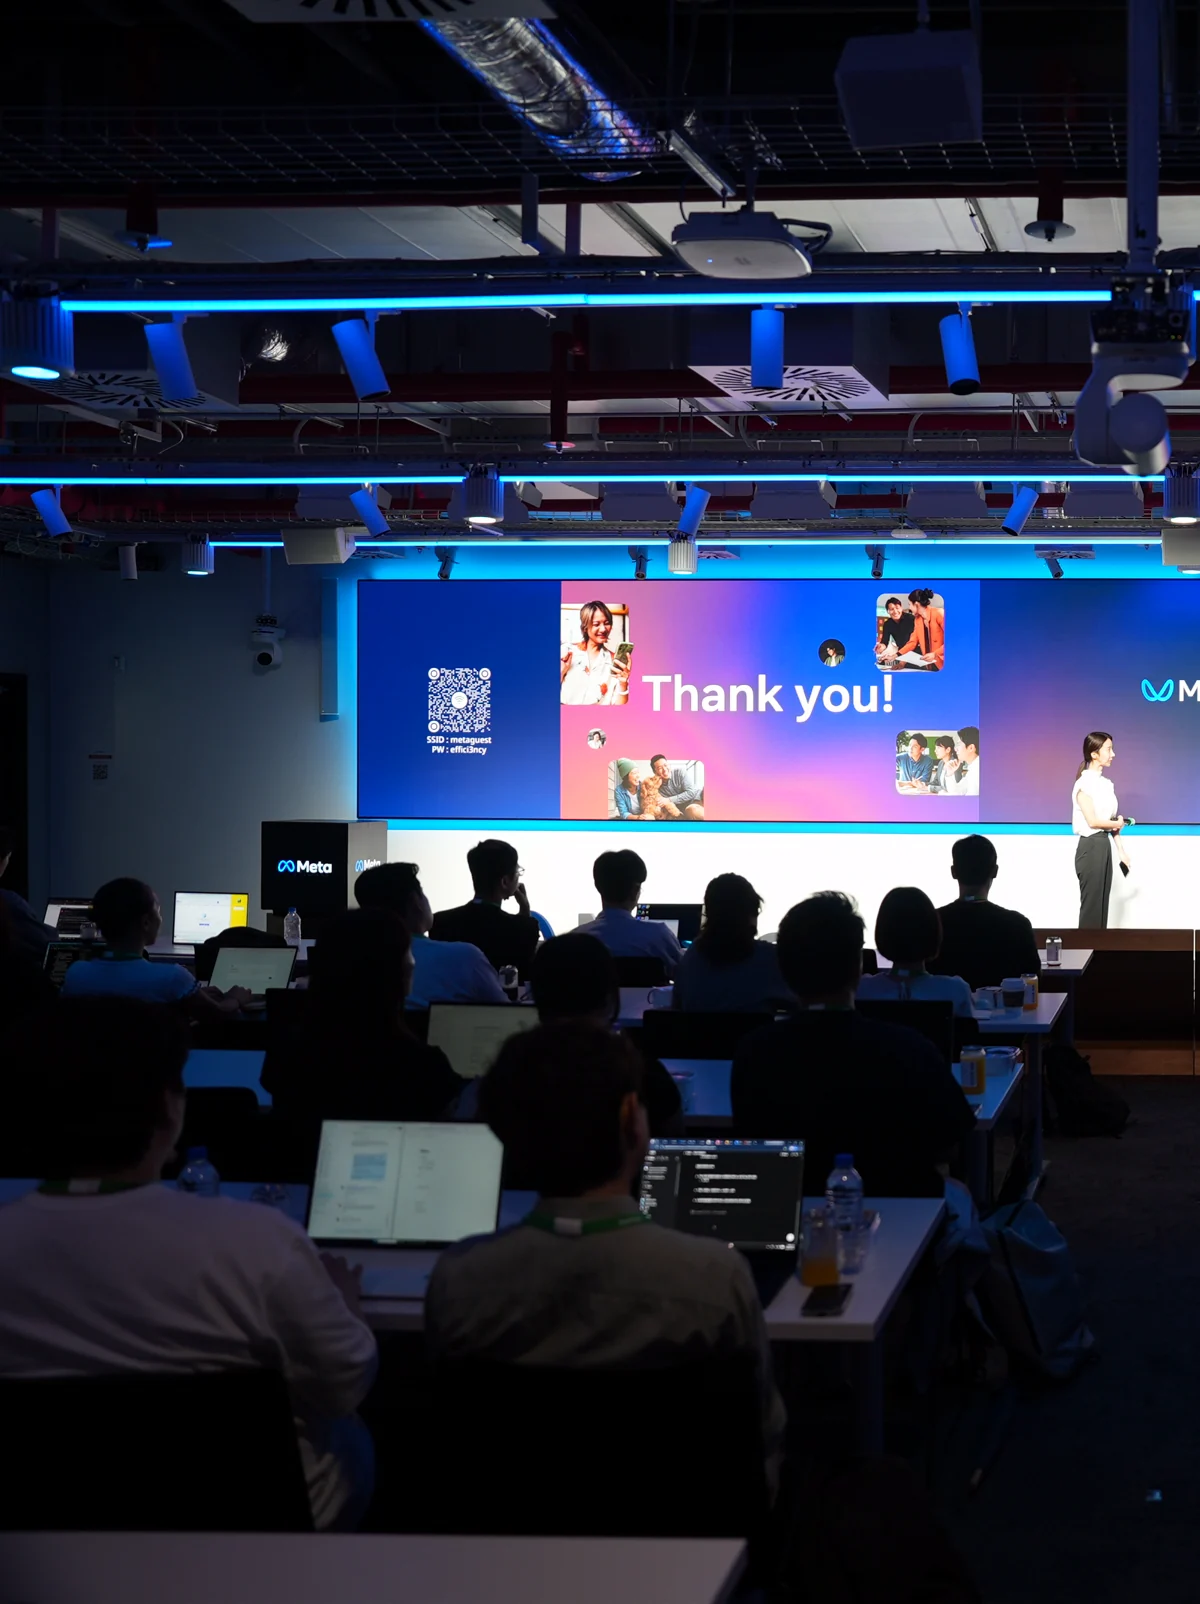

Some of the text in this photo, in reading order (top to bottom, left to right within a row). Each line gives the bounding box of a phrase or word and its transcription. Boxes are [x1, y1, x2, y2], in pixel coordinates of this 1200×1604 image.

[641, 674, 893, 723] Thank you!
[426, 735, 445, 744] SSID
[450, 736, 492, 746] metaguest
[431, 745, 445, 754] PW
[450, 745, 487, 756] effici3ncy
[296, 860, 333, 874] Meta
